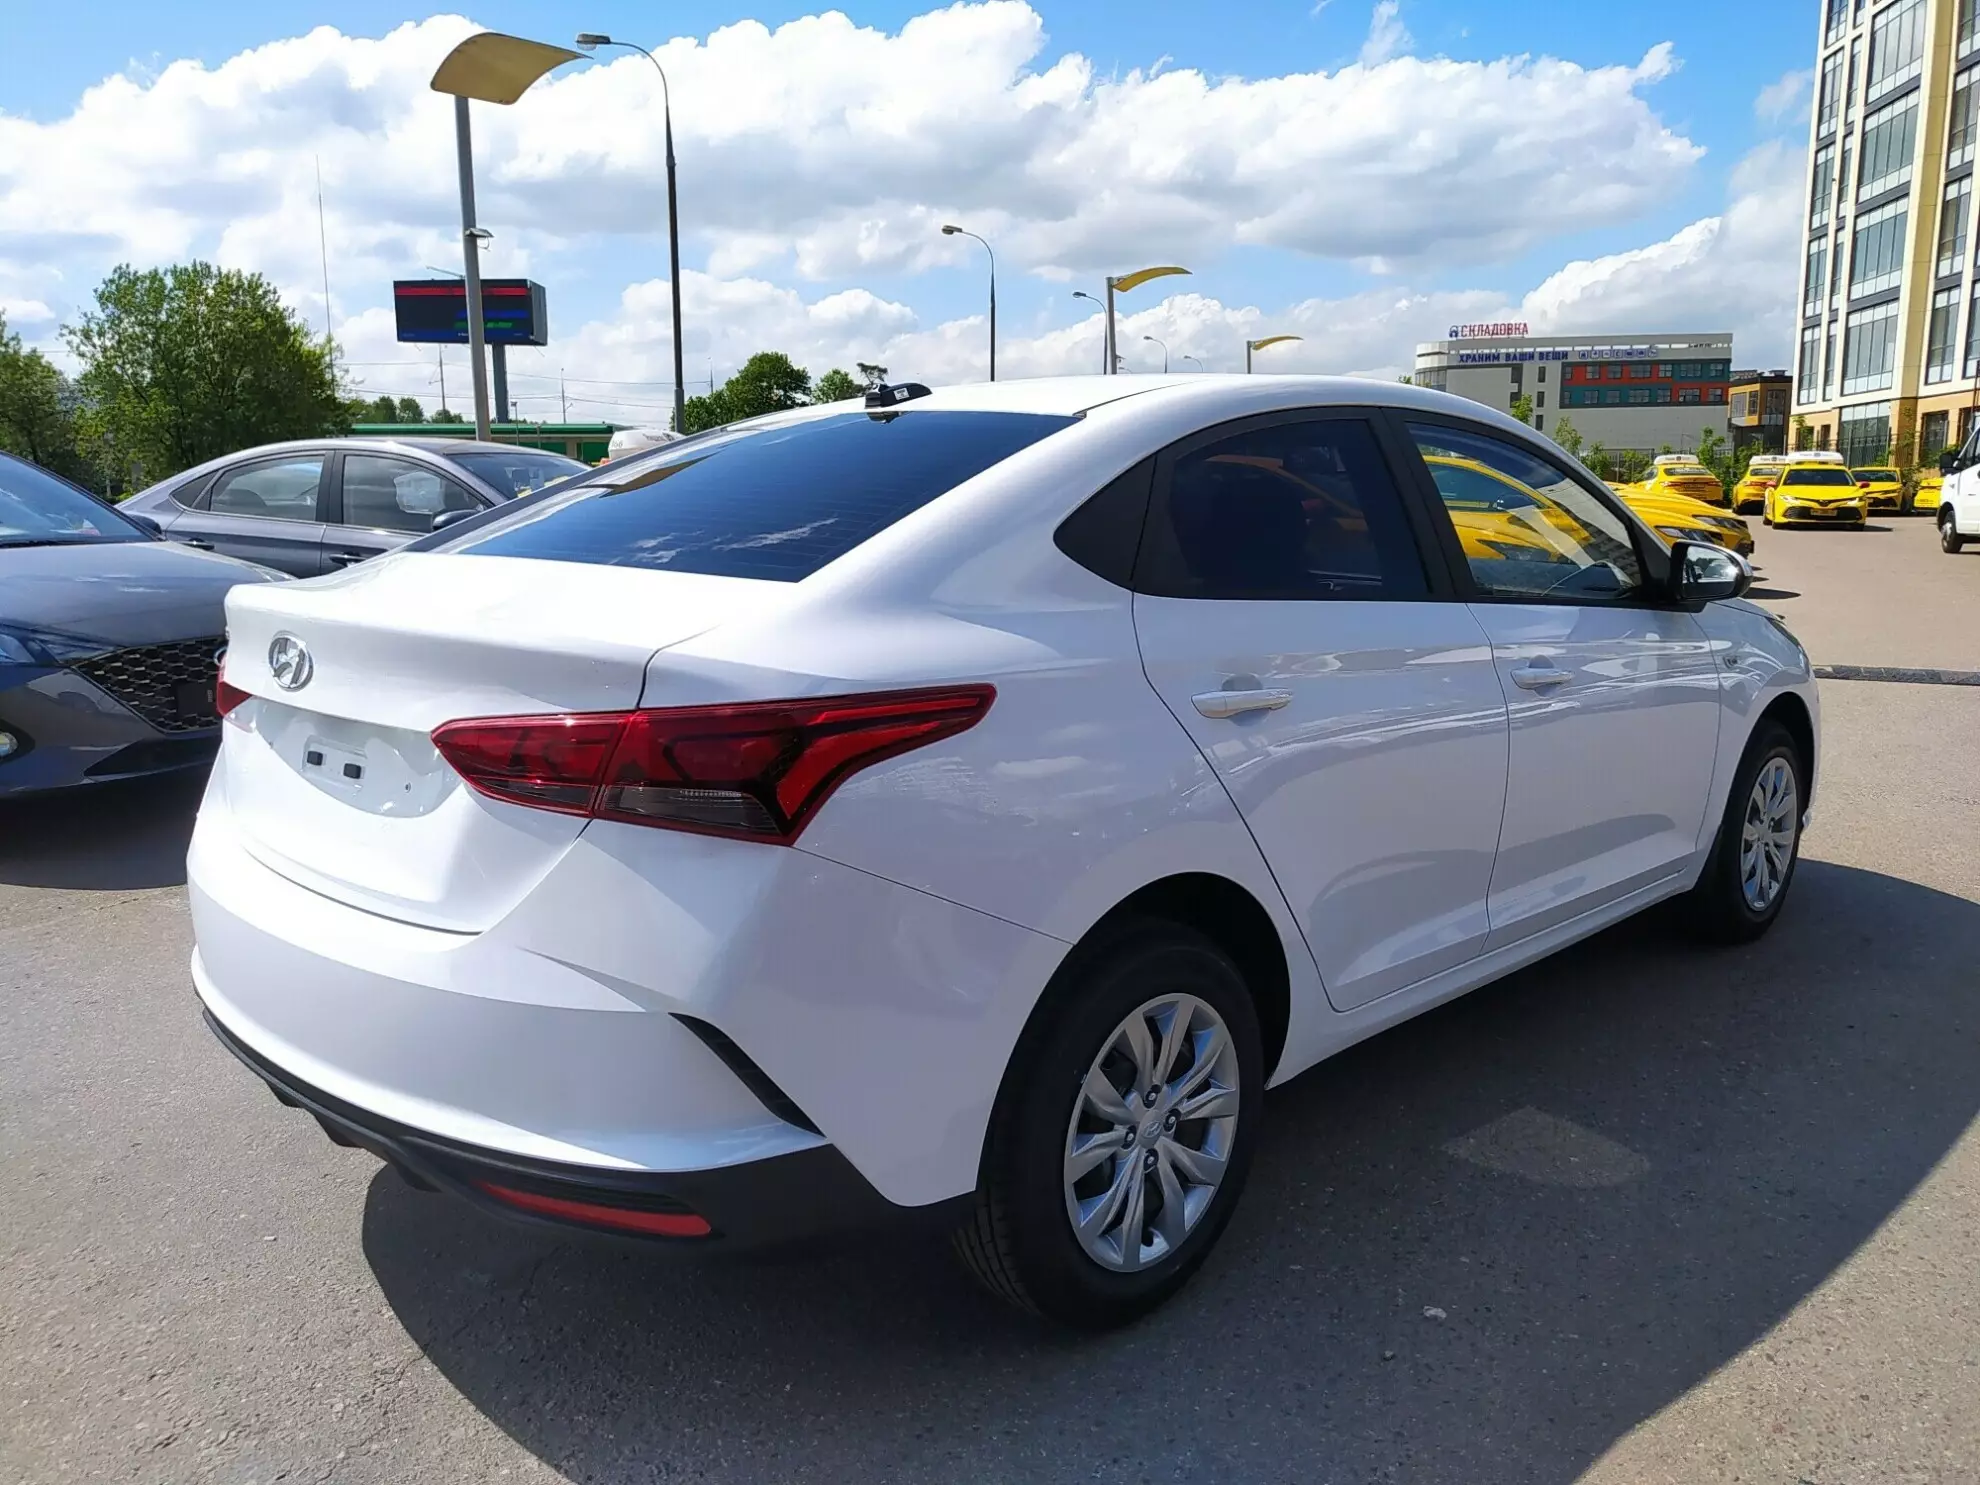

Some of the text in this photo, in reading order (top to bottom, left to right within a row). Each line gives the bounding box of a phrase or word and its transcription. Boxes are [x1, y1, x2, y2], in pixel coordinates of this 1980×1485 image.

[1461, 322, 1529, 338] СКЛАДОВКА
[1459, 349, 1569, 364] ХРАНИМ ВАШИ ВЕЩИ
